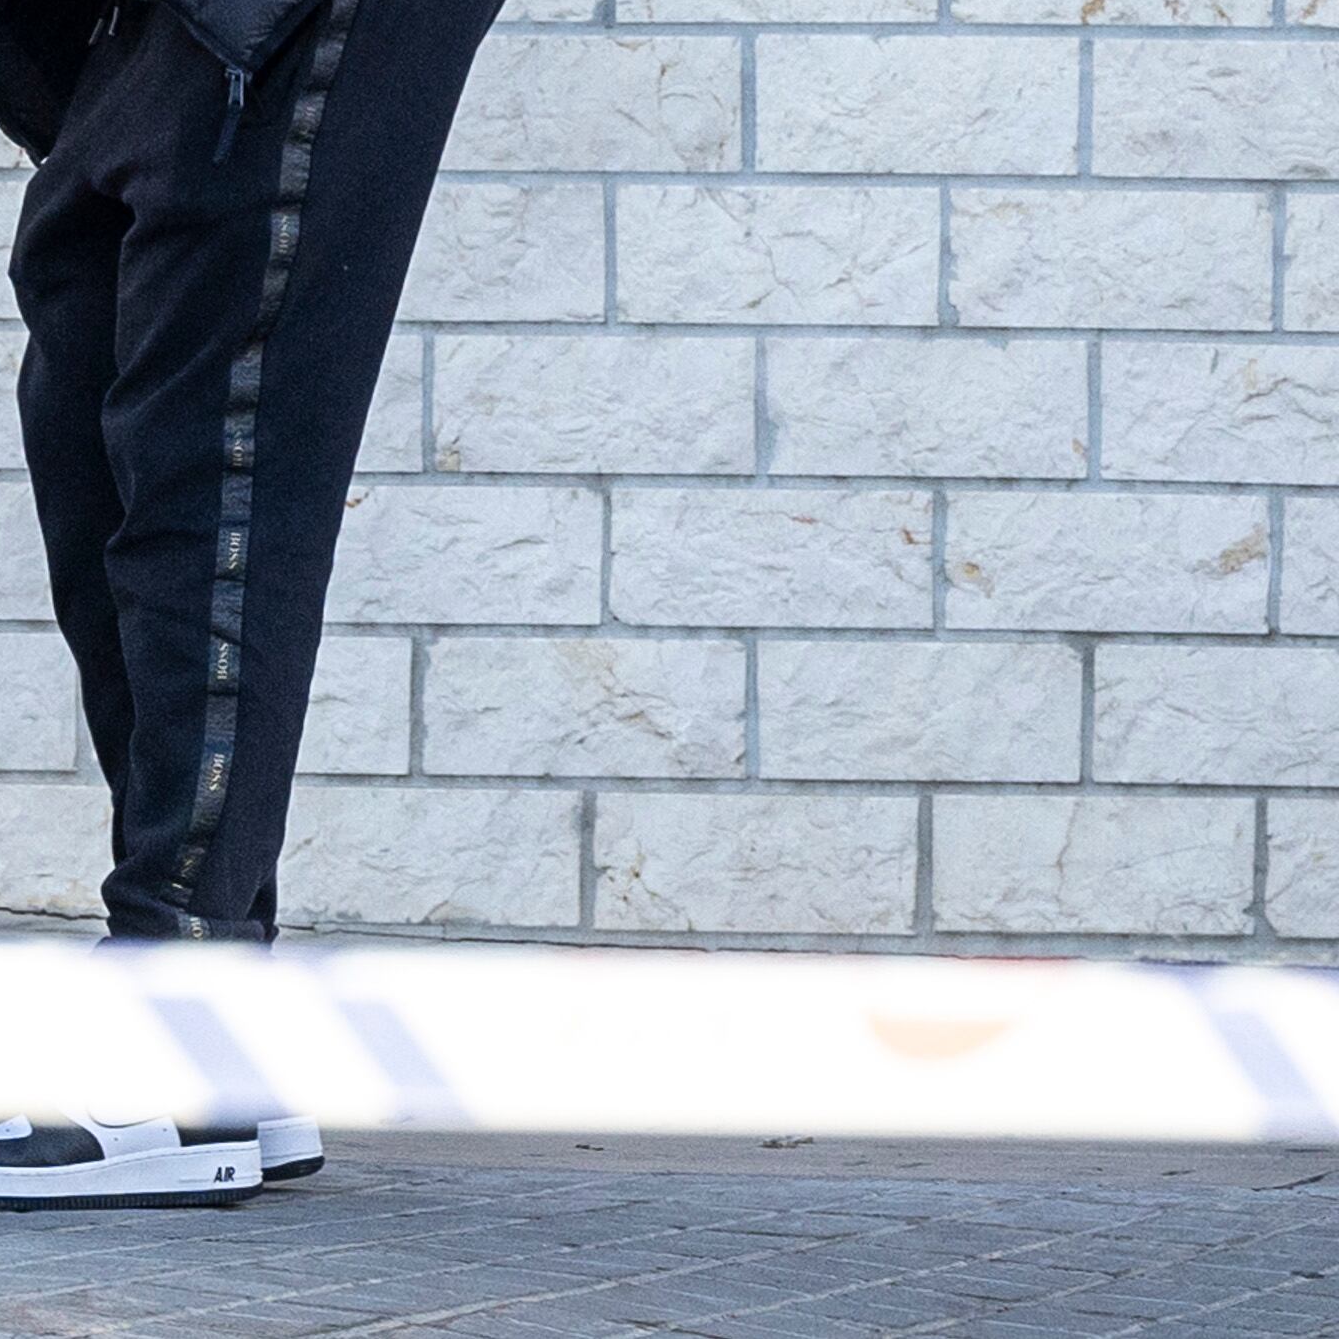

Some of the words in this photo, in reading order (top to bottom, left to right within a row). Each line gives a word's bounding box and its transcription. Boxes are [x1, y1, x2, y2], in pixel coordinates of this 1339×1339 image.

[228, 531, 242, 571] BOSS
[217, 641, 230, 680] BOSS
[208, 753, 226, 792] BOSS
[213, 1165, 236, 1183] AIR
